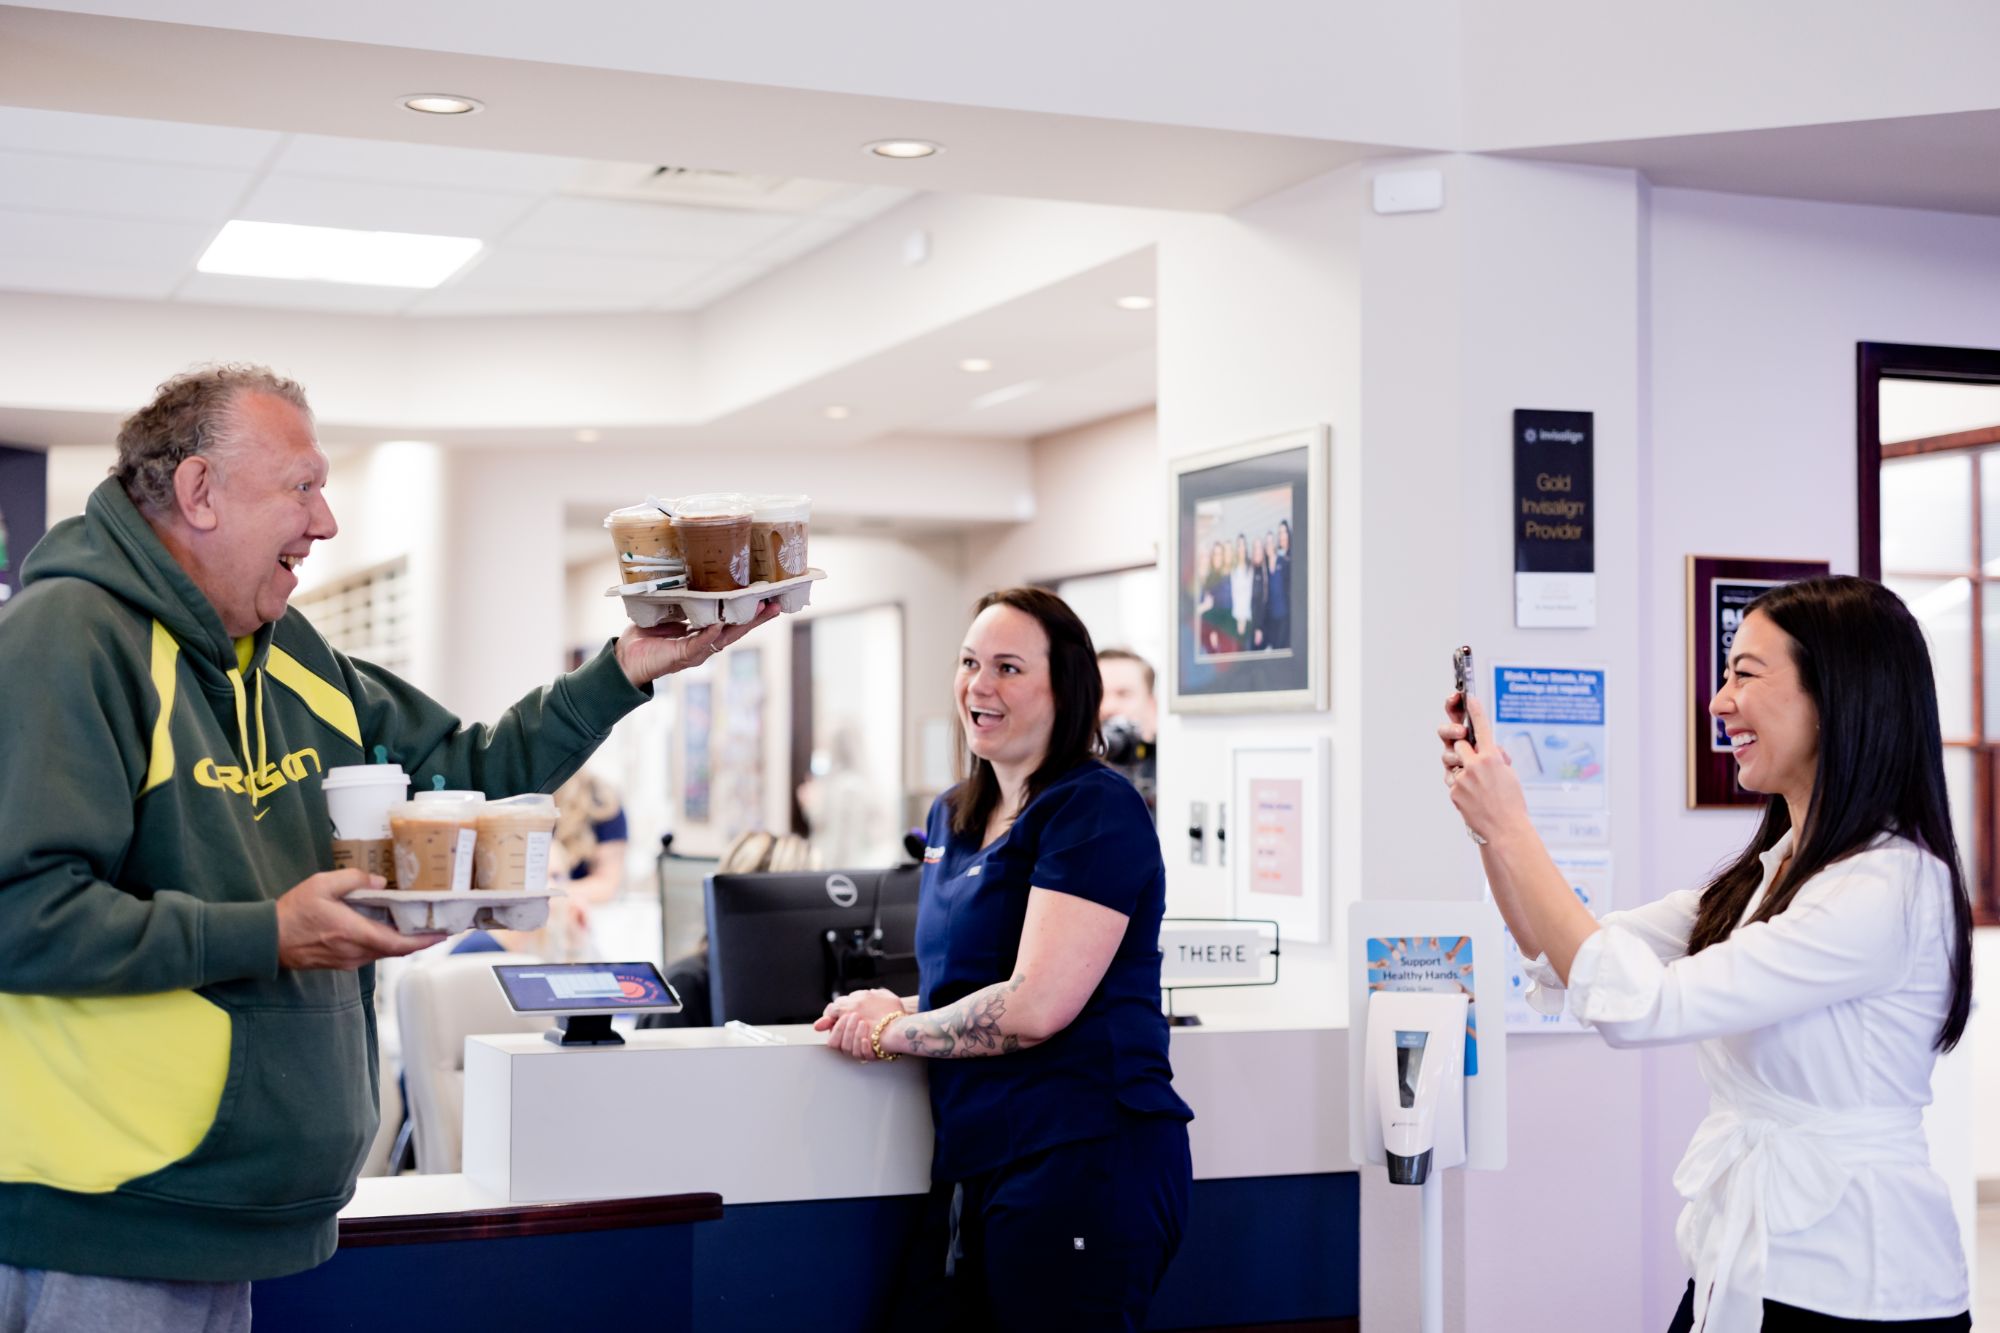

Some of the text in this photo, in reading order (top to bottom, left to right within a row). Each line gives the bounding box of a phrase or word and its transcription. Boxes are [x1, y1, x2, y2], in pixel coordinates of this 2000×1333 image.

[1539, 429, 1584, 443] invisalign
[1536, 473, 1571, 491] Gold
[1525, 521, 1583, 539] Provider
[193, 747, 322, 798] ORGON
[1178, 945, 1247, 962] THERE
[1400, 957, 1441, 968] Support
[1383, 970, 1423, 981] Healthy
